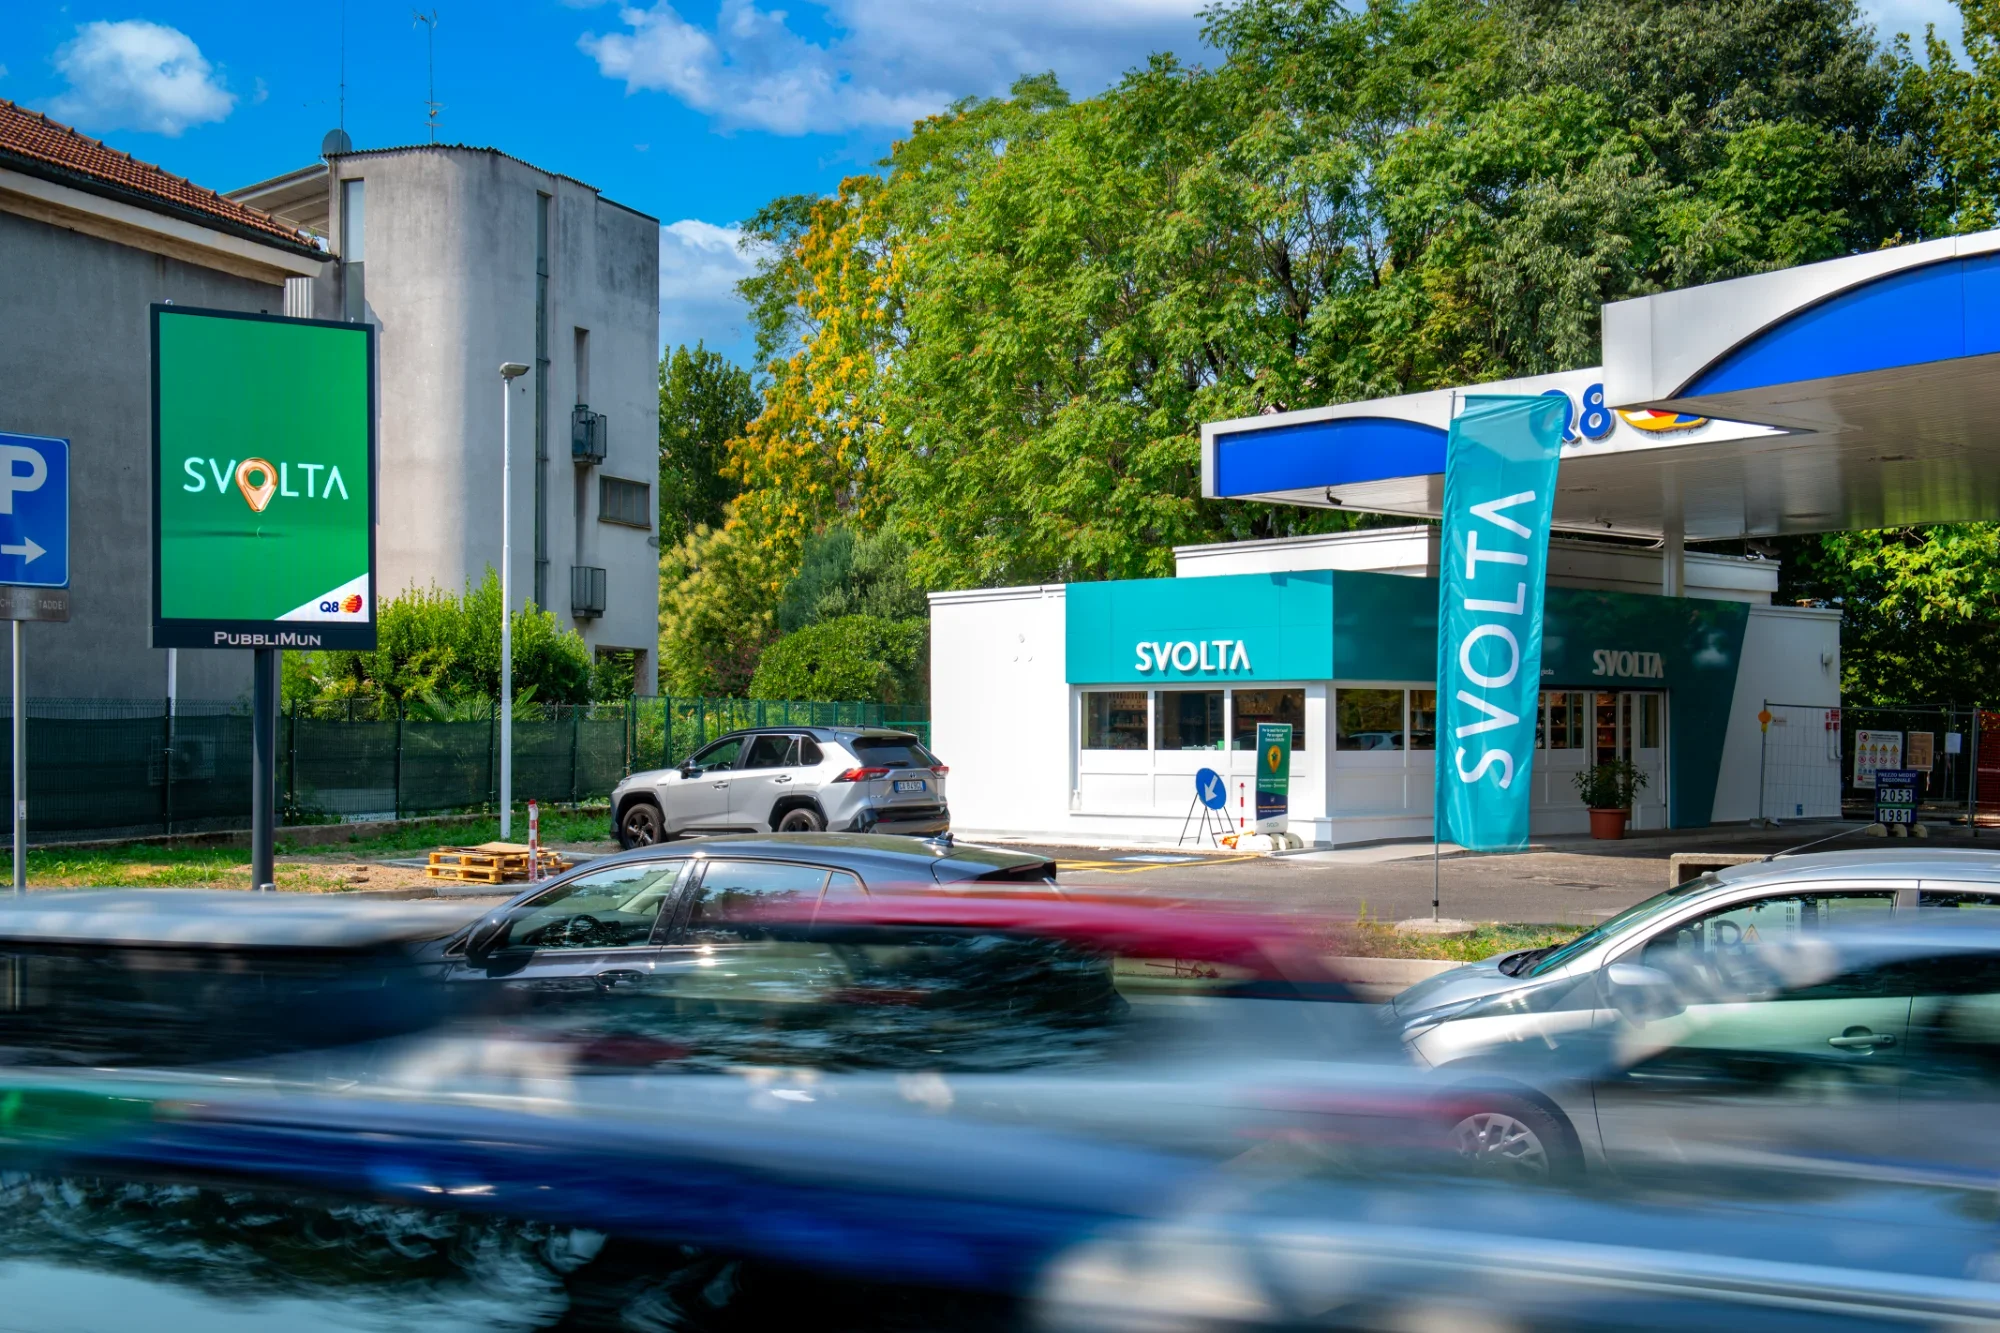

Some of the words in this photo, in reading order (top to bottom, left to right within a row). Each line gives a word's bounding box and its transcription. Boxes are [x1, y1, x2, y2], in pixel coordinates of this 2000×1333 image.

[0, 444, 47, 515] P
[183, 457, 349, 512] SVOLTA
[320, 601, 339, 613] Q8
[1135, 640, 1251, 671] SVOLTA
[1455, 490, 1536, 790] SVOLTA
[1592, 649, 1664, 678] SVOLTA
